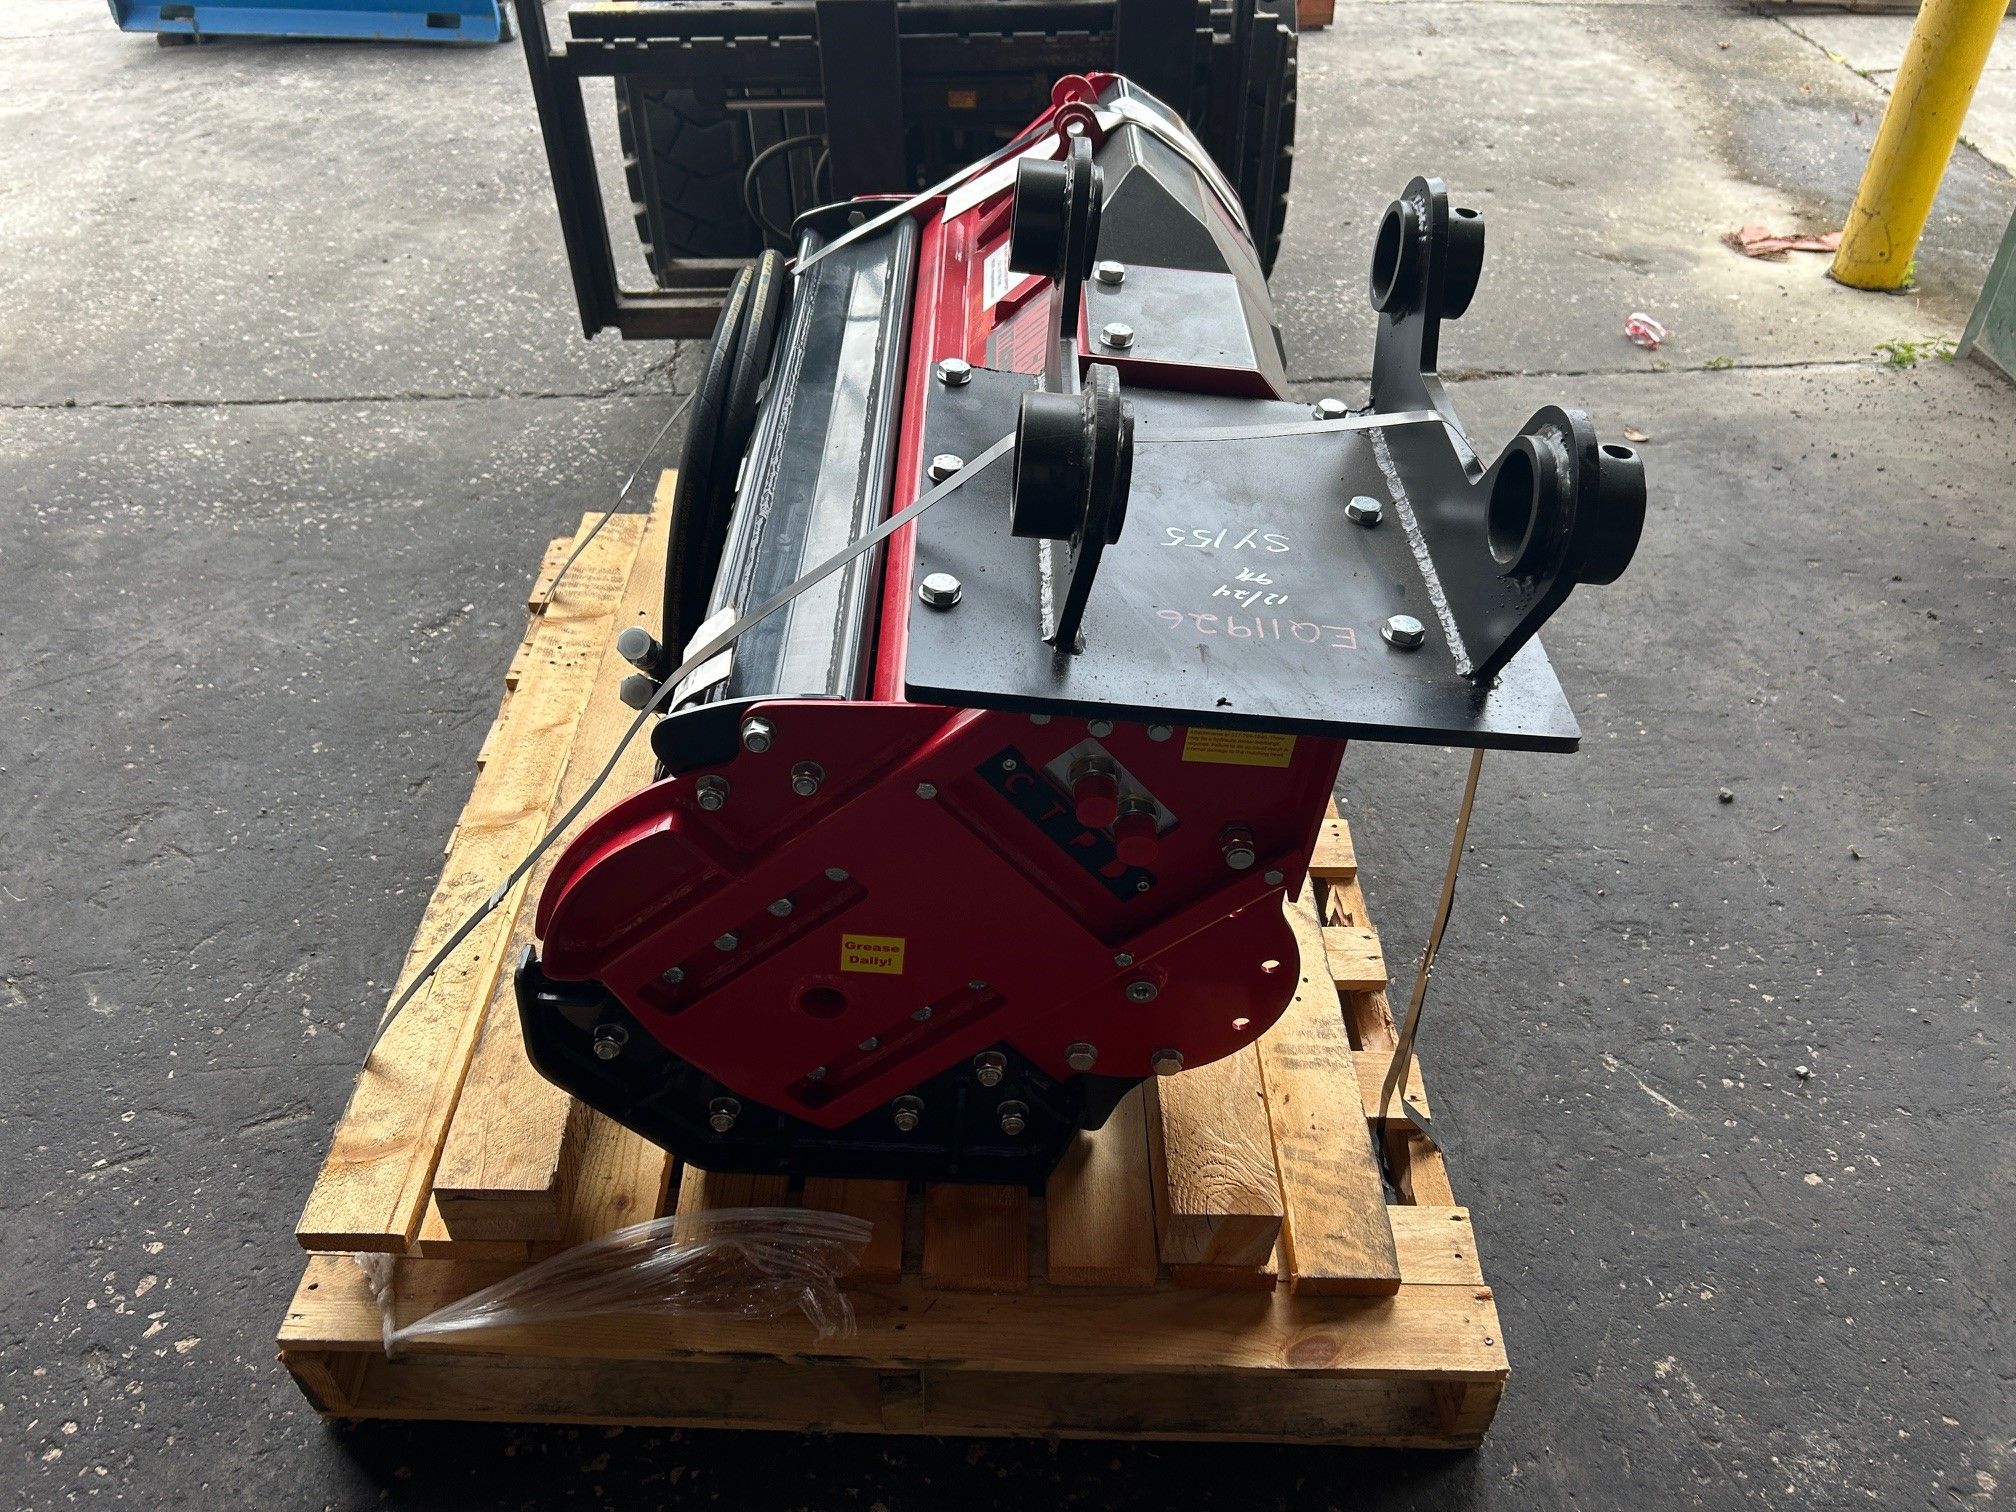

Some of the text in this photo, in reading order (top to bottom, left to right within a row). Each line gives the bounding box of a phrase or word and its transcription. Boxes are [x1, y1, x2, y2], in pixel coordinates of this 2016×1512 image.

[1212, 585, 1289, 608] 12/24
[1156, 609, 1357, 649] EQ11926
[846, 942, 900, 953] Grease
[850, 956, 893, 967] Daily!
